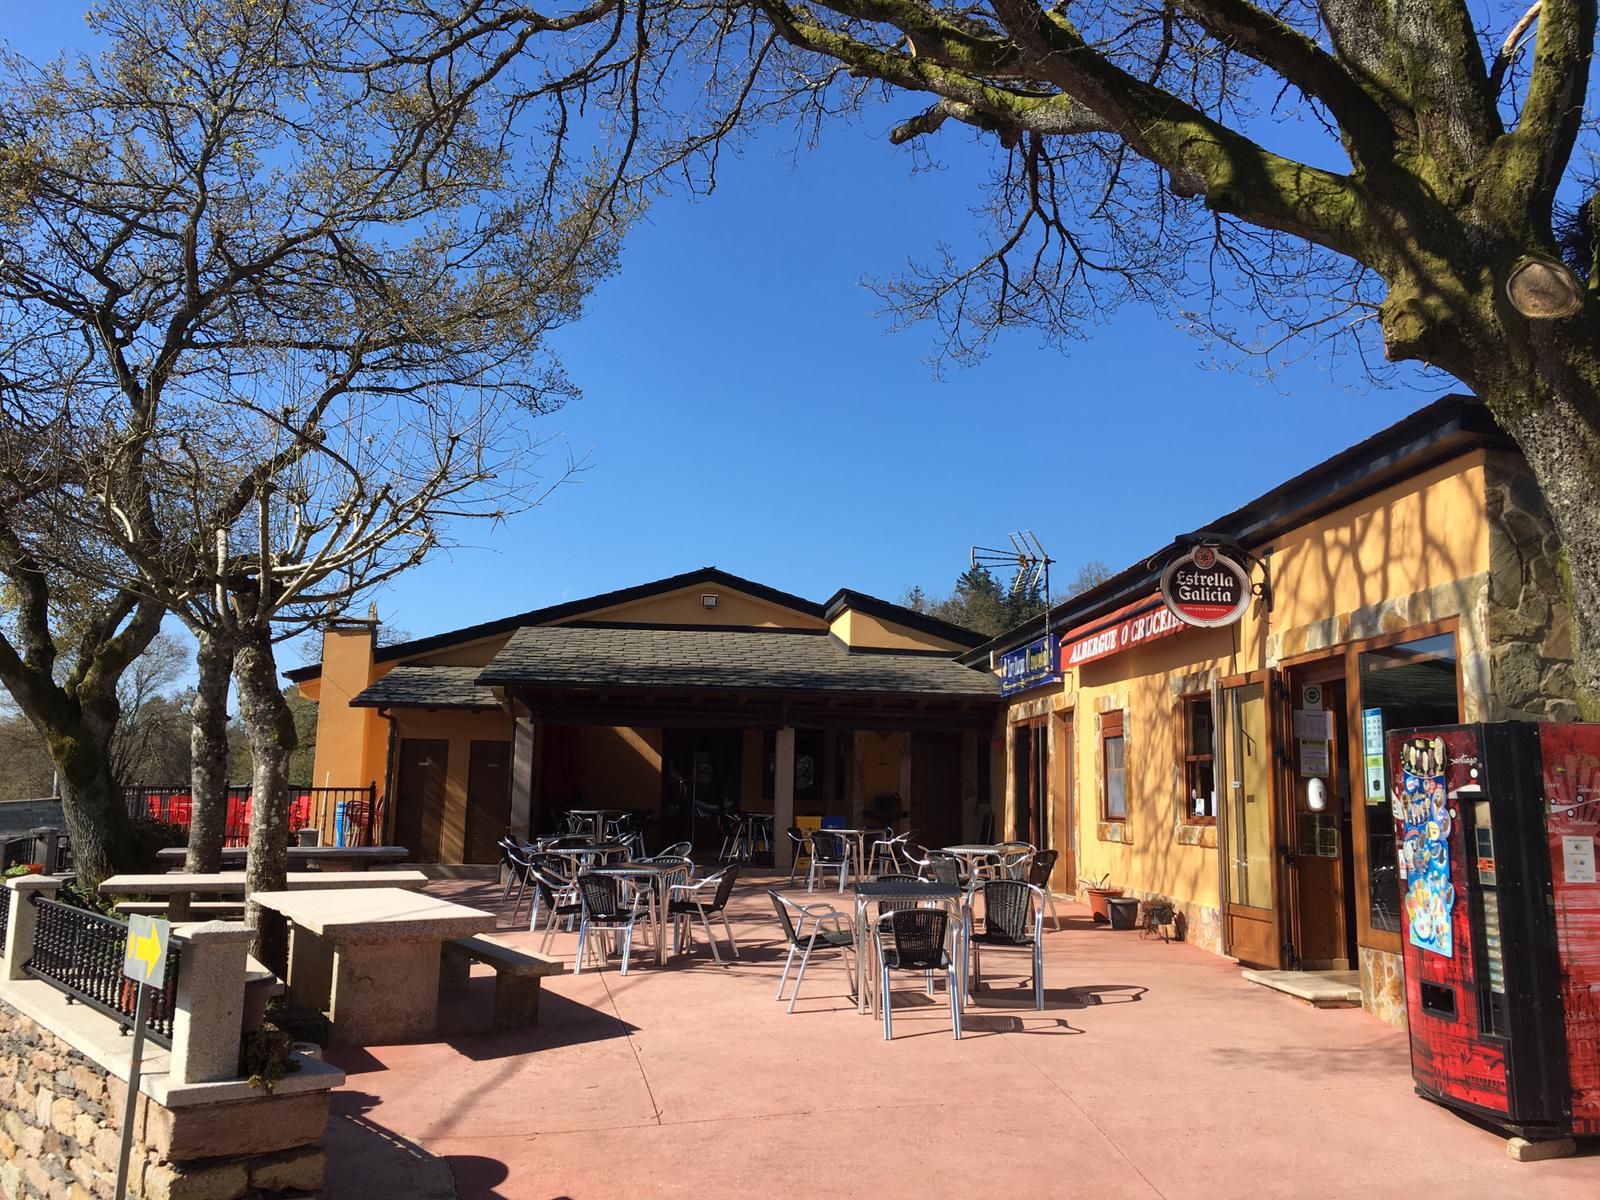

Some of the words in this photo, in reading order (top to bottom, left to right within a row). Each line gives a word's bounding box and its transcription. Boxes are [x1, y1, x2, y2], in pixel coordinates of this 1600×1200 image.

[1176, 571, 1234, 587] Estrella
[1179, 585, 1232, 602] Galicia
[1069, 629, 1118, 664] ALBERGUE
[1121, 624, 1129, 646] O
